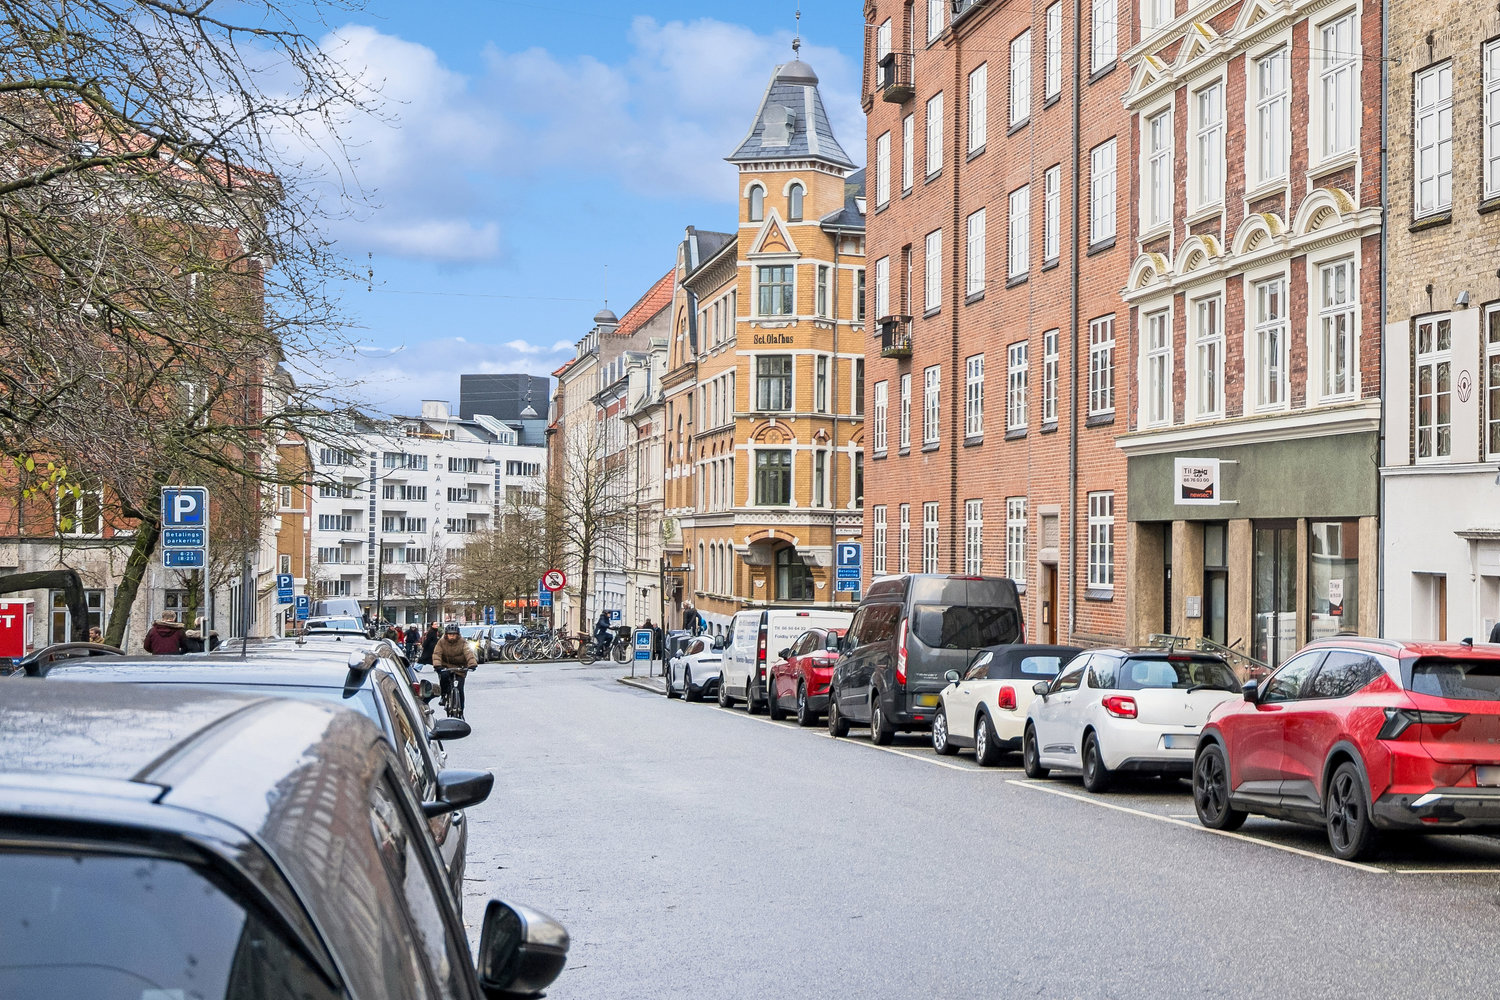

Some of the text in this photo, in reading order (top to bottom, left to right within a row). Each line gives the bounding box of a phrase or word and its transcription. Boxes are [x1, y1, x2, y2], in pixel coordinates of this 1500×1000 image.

[174, 495, 197, 523] P
[843, 546, 857, 564] P
[280, 576, 290, 588] P
[299, 597, 307, 607] P
[612, 611, 619, 620] P
